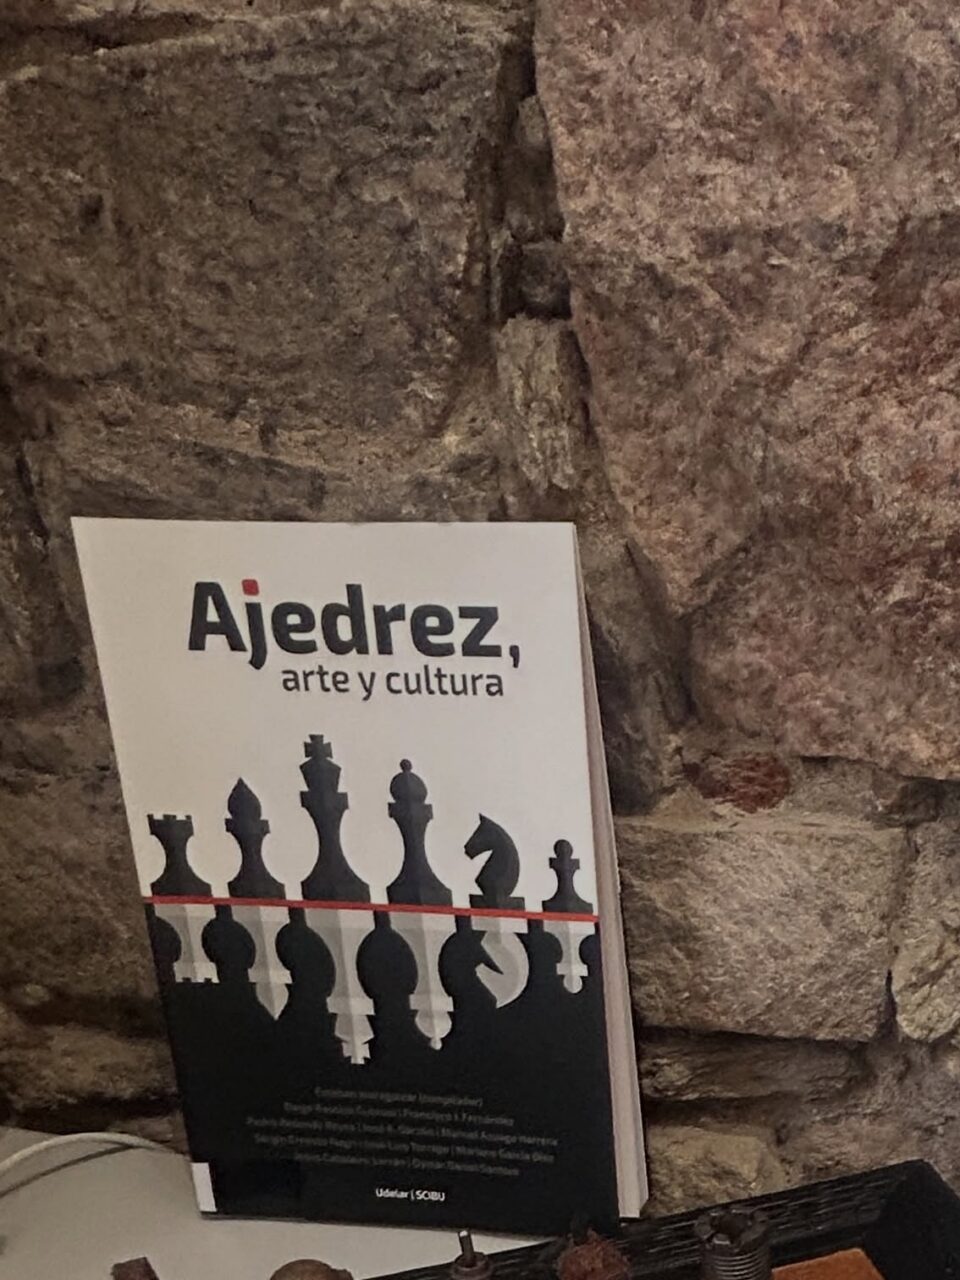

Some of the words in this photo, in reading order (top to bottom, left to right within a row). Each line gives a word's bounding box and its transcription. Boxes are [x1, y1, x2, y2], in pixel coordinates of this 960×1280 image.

[188, 579, 520, 670] Ajedrez,
[281, 664, 350, 693] arte
[357, 671, 377, 701] y
[386, 664, 504, 697] cultura
